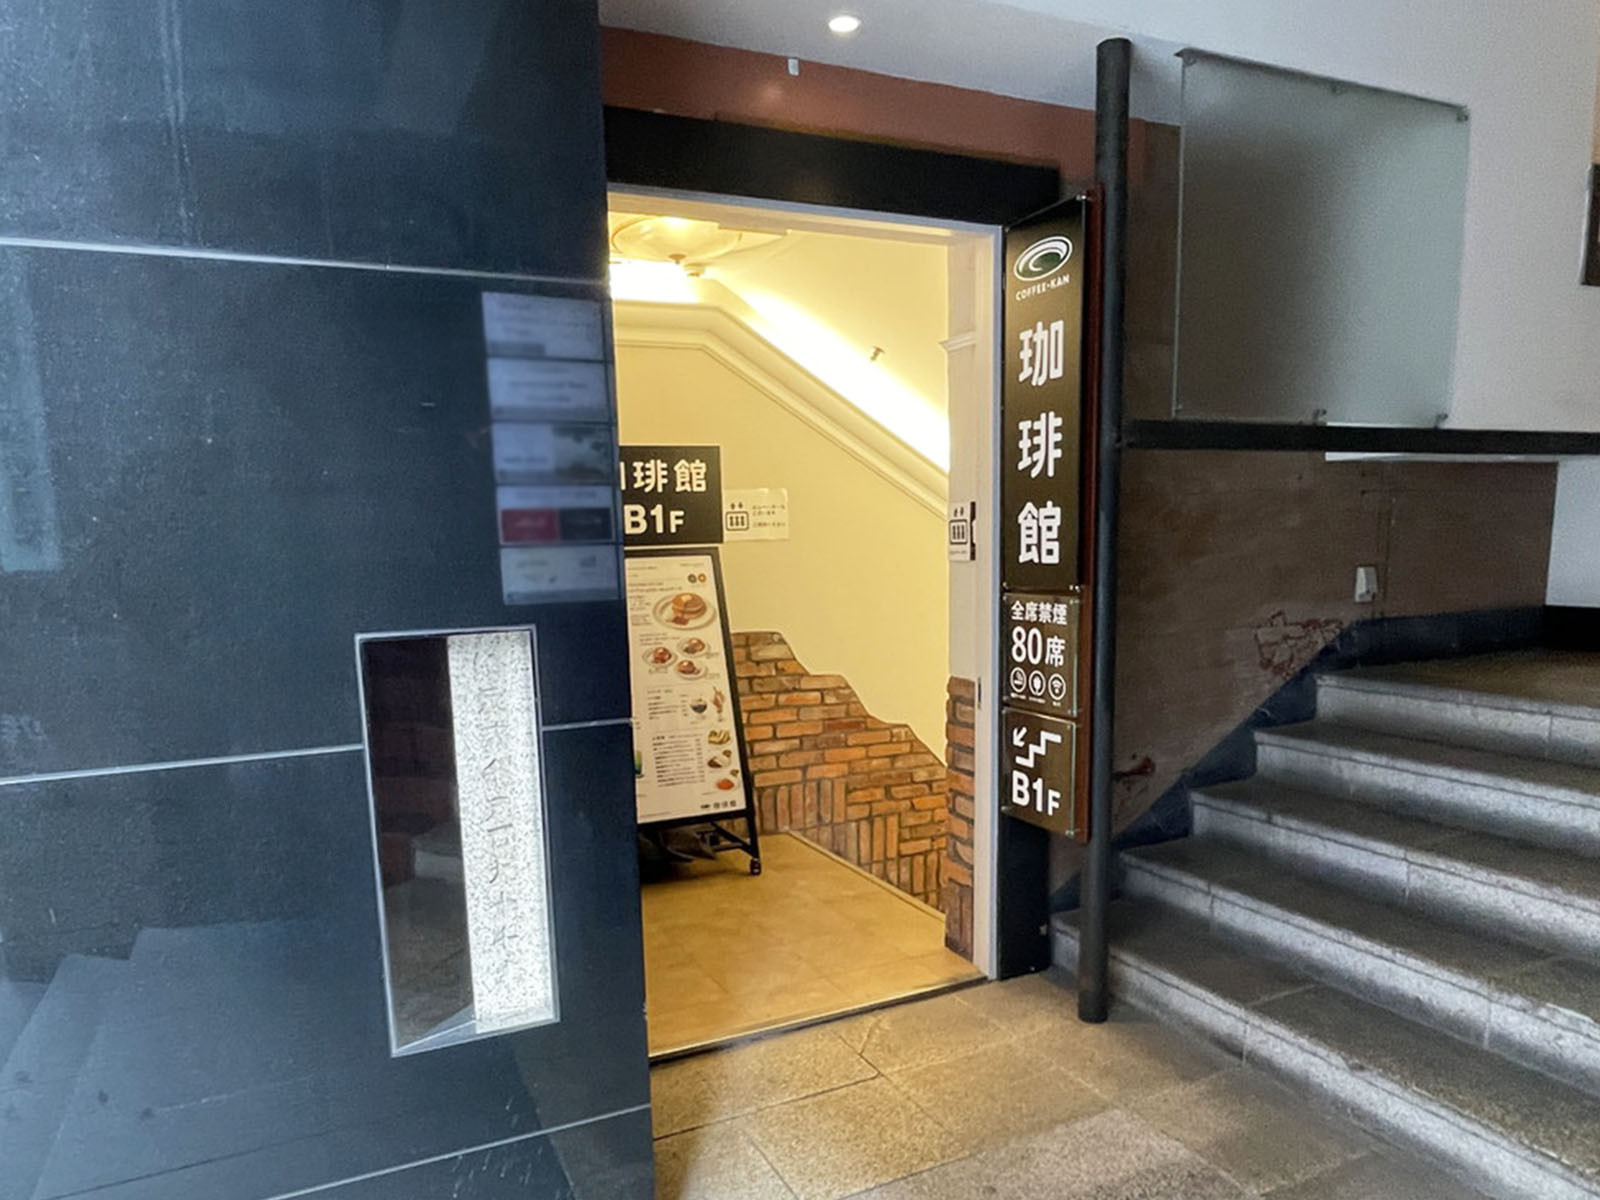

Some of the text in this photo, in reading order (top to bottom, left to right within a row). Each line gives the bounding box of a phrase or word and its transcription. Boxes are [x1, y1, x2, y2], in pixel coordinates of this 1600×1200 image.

[1017, 319, 1064, 564] 珈琲館
[620, 459, 707, 493] 琲館
[624, 504, 685, 534] B1F
[1011, 600, 1068, 625] 全席禁煙
[1012, 770, 1062, 816] B1F
